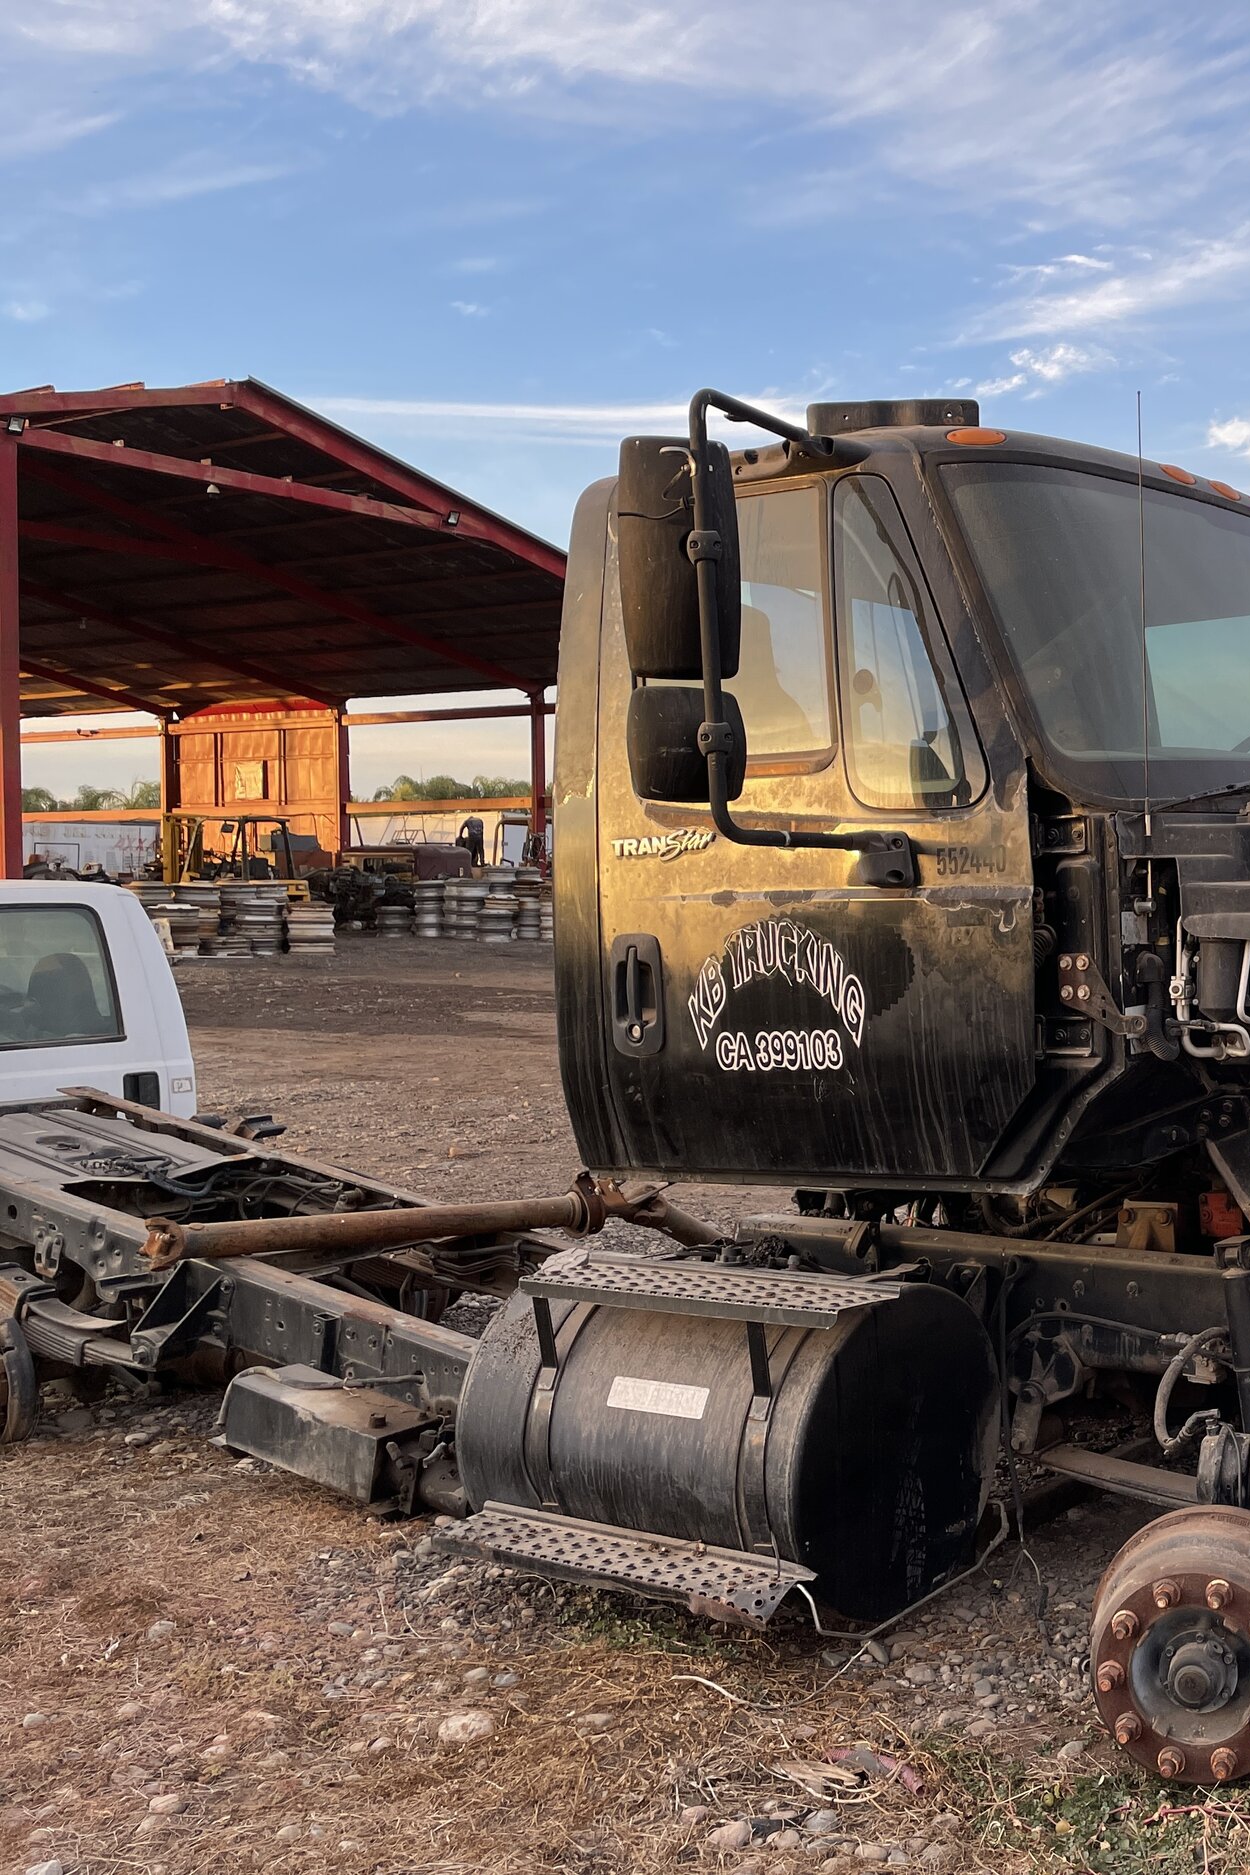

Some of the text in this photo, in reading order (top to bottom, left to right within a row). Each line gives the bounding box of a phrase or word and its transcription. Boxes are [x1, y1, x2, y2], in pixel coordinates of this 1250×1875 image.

[937, 845, 1006, 875] 552440
[716, 1029, 843, 1071] CA 399103
